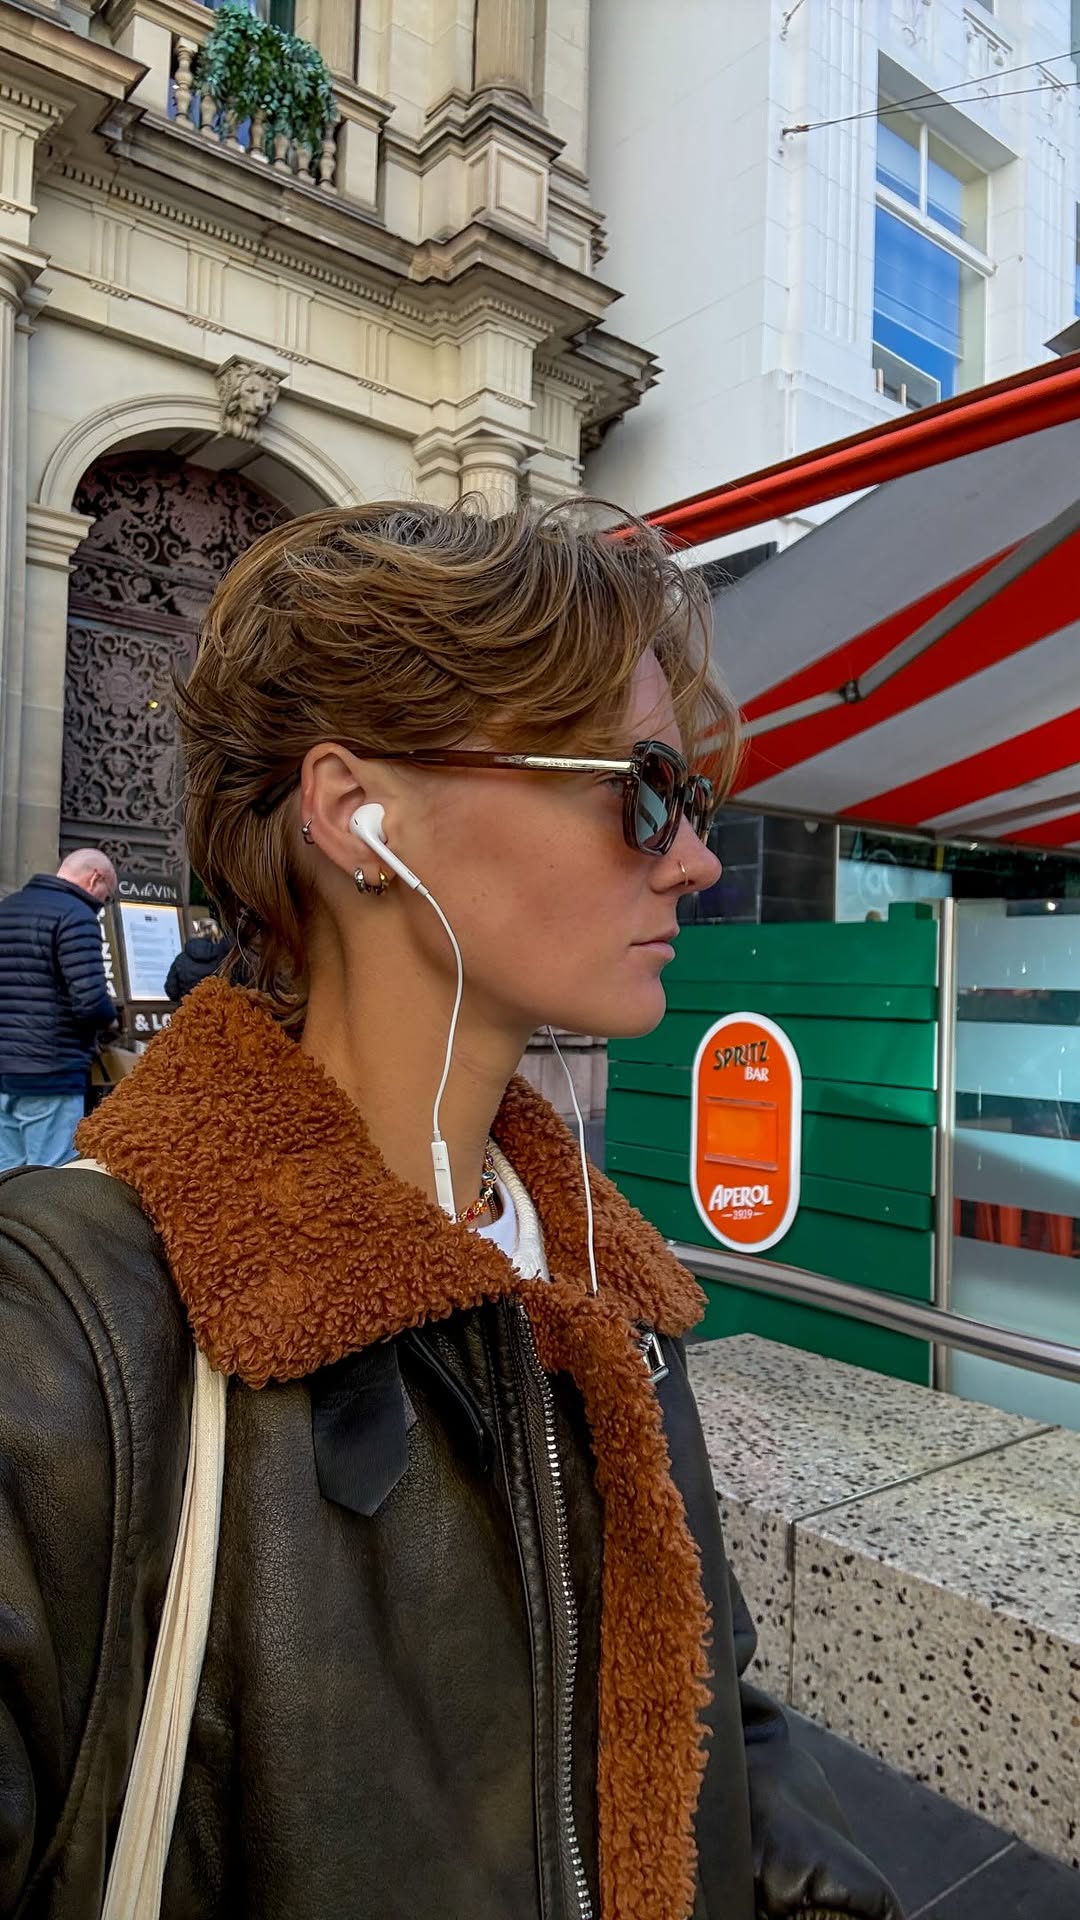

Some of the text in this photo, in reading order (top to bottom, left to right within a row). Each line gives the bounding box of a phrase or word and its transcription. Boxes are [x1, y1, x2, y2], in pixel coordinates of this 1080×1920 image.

[118, 880, 140, 896] CA
[152, 884, 177, 899] VIN
[135, 1013, 151, 1032] &
[713, 1040, 769, 1071] SPRITZ
[744, 1066, 770, 1082] BAR
[708, 1184, 774, 1211] APEROL
